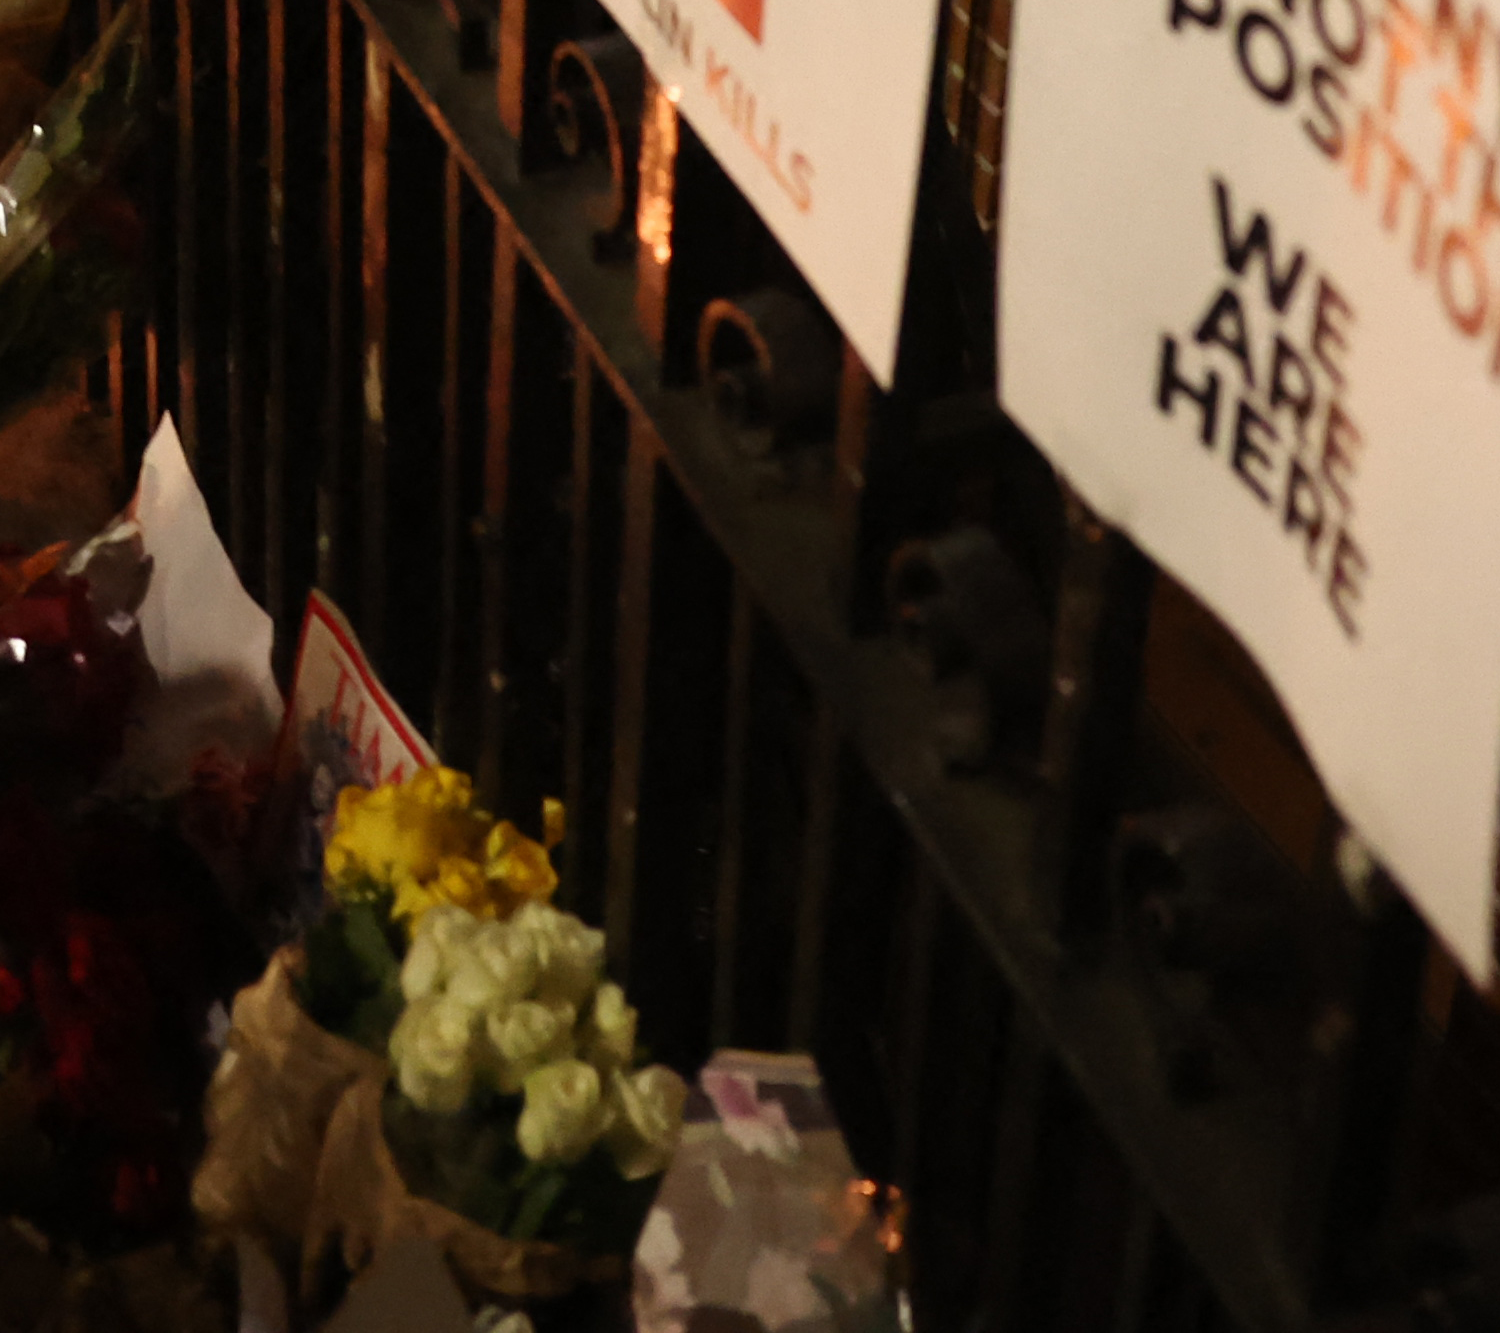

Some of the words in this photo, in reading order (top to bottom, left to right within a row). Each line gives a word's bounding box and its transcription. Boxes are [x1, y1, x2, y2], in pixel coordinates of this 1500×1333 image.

[704, 45, 816, 216] KILLS
[1212, 172, 1357, 389] WE
[1155, 334, 1369, 643] HERE
[1192, 286, 1362, 519] ARE
